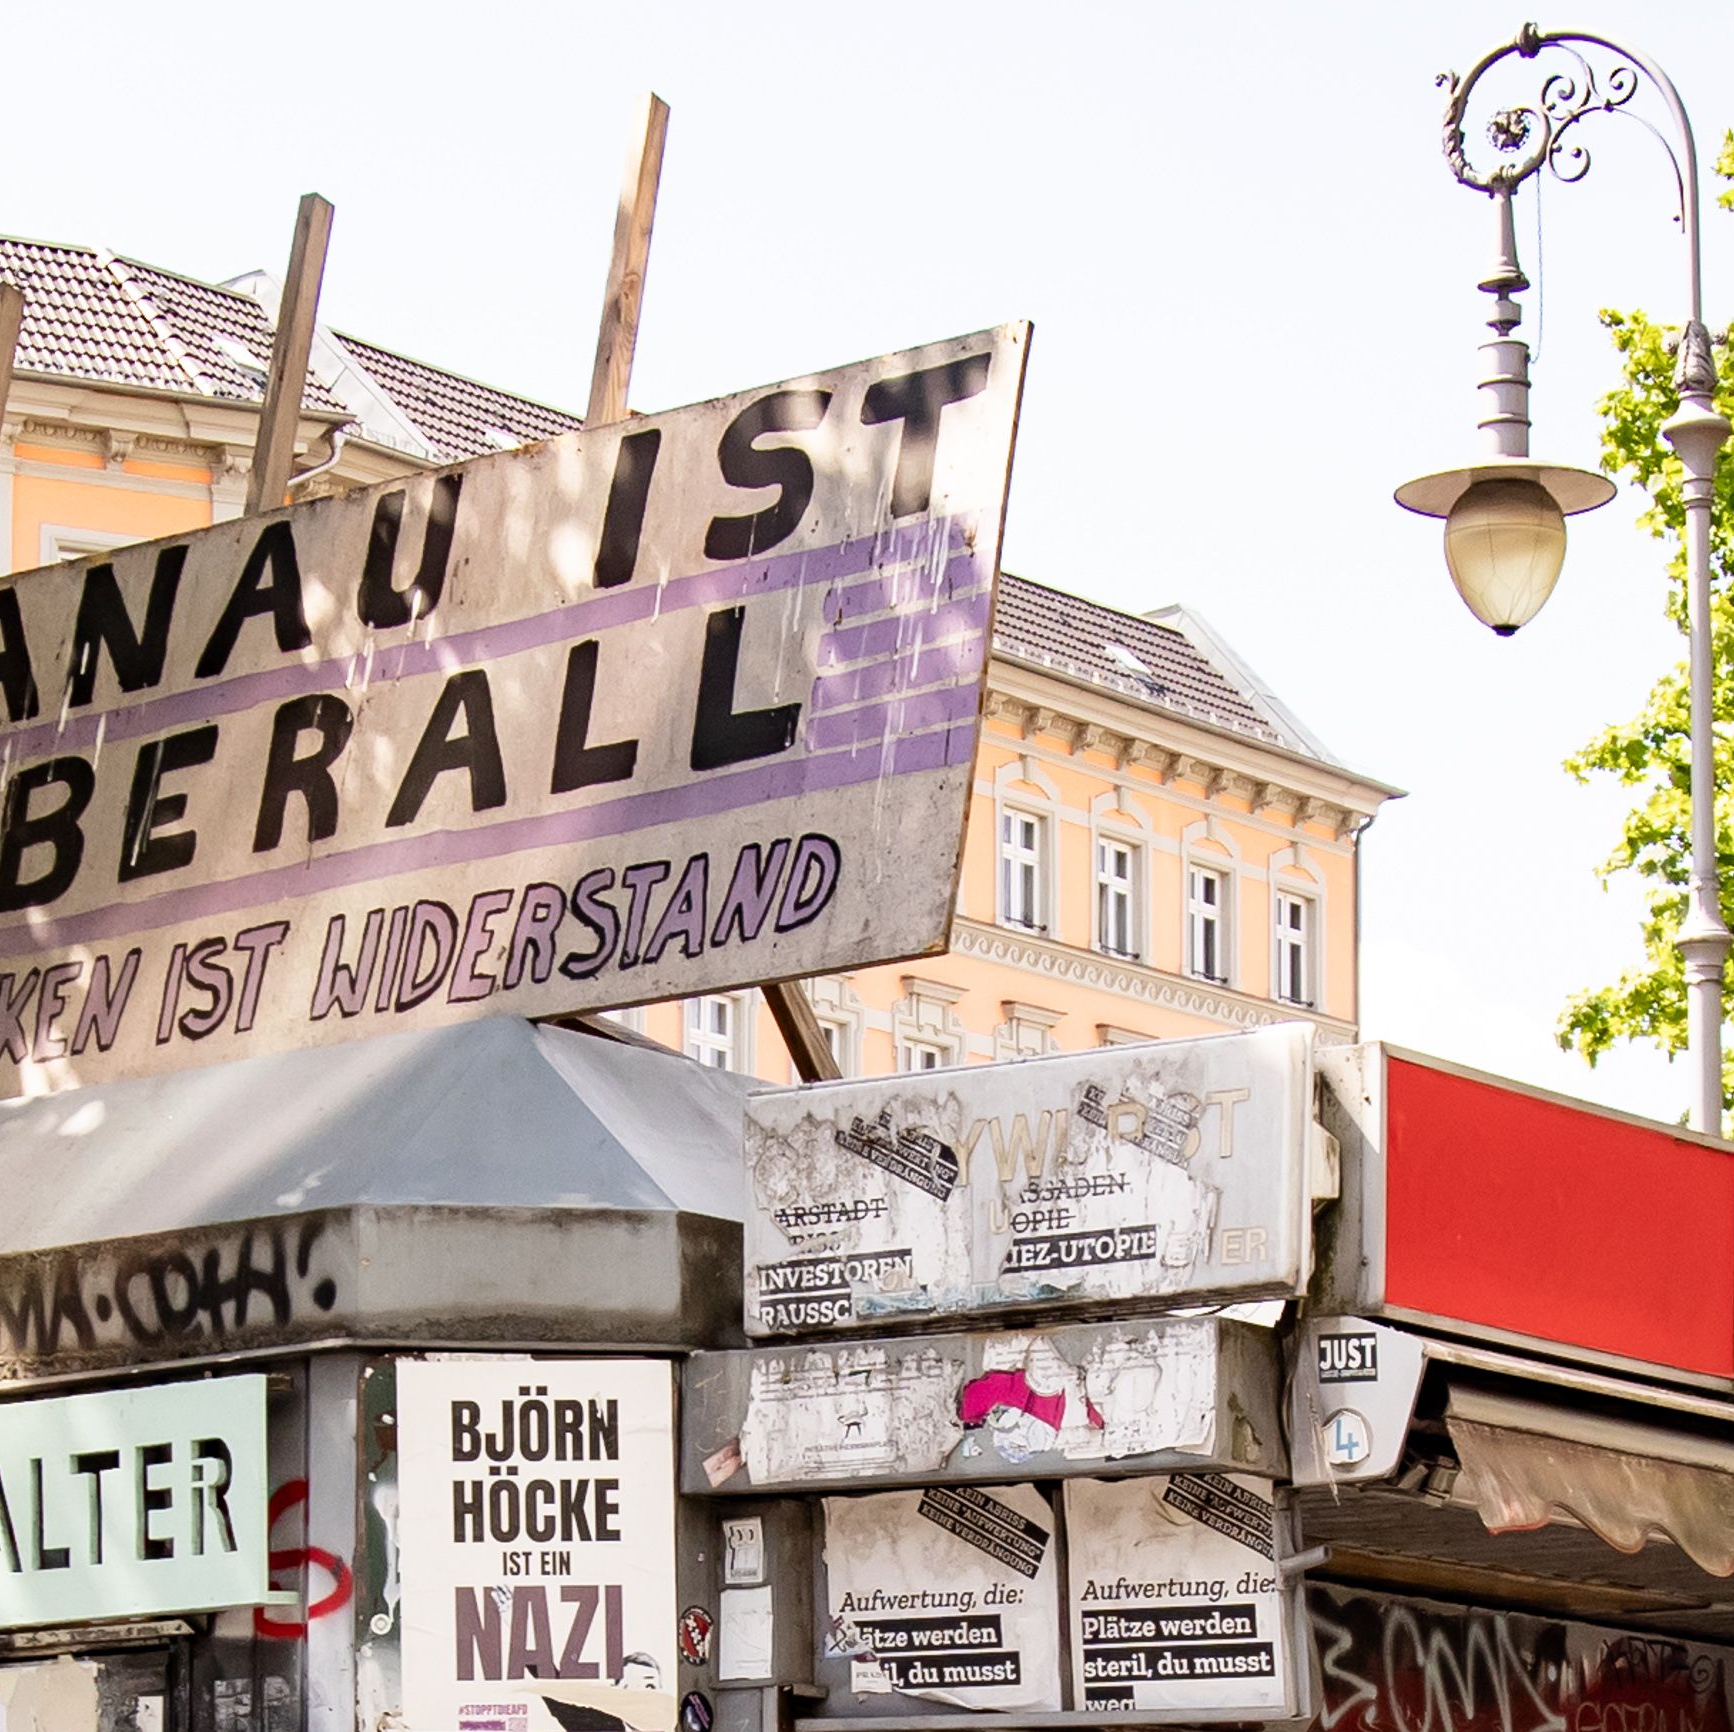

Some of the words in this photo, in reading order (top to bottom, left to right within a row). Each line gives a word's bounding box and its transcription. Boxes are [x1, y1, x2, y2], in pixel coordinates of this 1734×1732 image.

[592, 350, 994, 589] IST
[156, 921, 289, 1046] IST
[310, 833, 844, 1021] WIDERSTAND
[1009, 1231, 1157, 1269] IEZ-UTOPIE
[1319, 1338, 1376, 1371] JUST
[451, 1385, 619, 1462] BJÖRN
[453, 1466, 622, 1544] HÖCKE
[985, 1501, 1027, 1530] ABRISS
[503, 1551, 532, 1576] IST
[541, 1550, 572, 1576] EIN
[840, 1585, 976, 1613] Aufwertung,
[982, 1585, 1024, 1607] die:
[1080, 1576, 1225, 1603] Aufwertung,
[454, 1585, 624, 1682] NAZI
[912, 1625, 997, 1645] werden
[1083, 1615, 1156, 1643] Plätze
[1160, 1613, 1251, 1637] werden
[908, 1663, 937, 1684] du
[940, 1661, 1017, 1684] musst
[1083, 1650, 1155, 1680] steril,
[1159, 1651, 1188, 1675] du
[1194, 1651, 1271, 1674] musst
